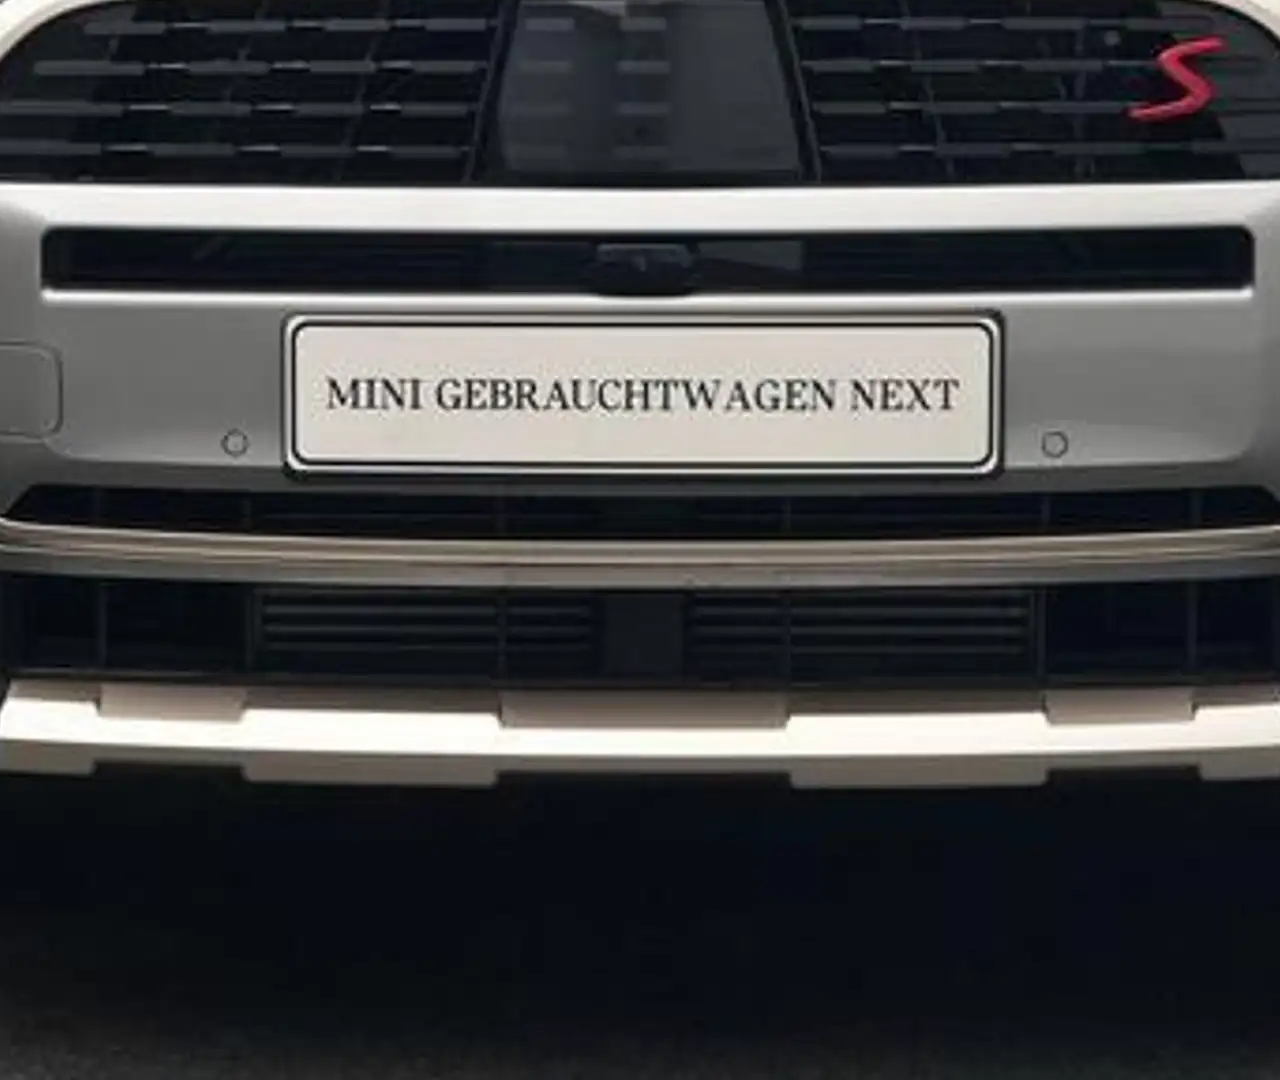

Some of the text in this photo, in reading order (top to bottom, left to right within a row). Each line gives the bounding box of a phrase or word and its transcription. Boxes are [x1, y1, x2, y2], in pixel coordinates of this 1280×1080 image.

[1128, 36, 1228, 122] S
[326, 376, 961, 413] MINI GEBRAUCHTWAGEN NEXT
